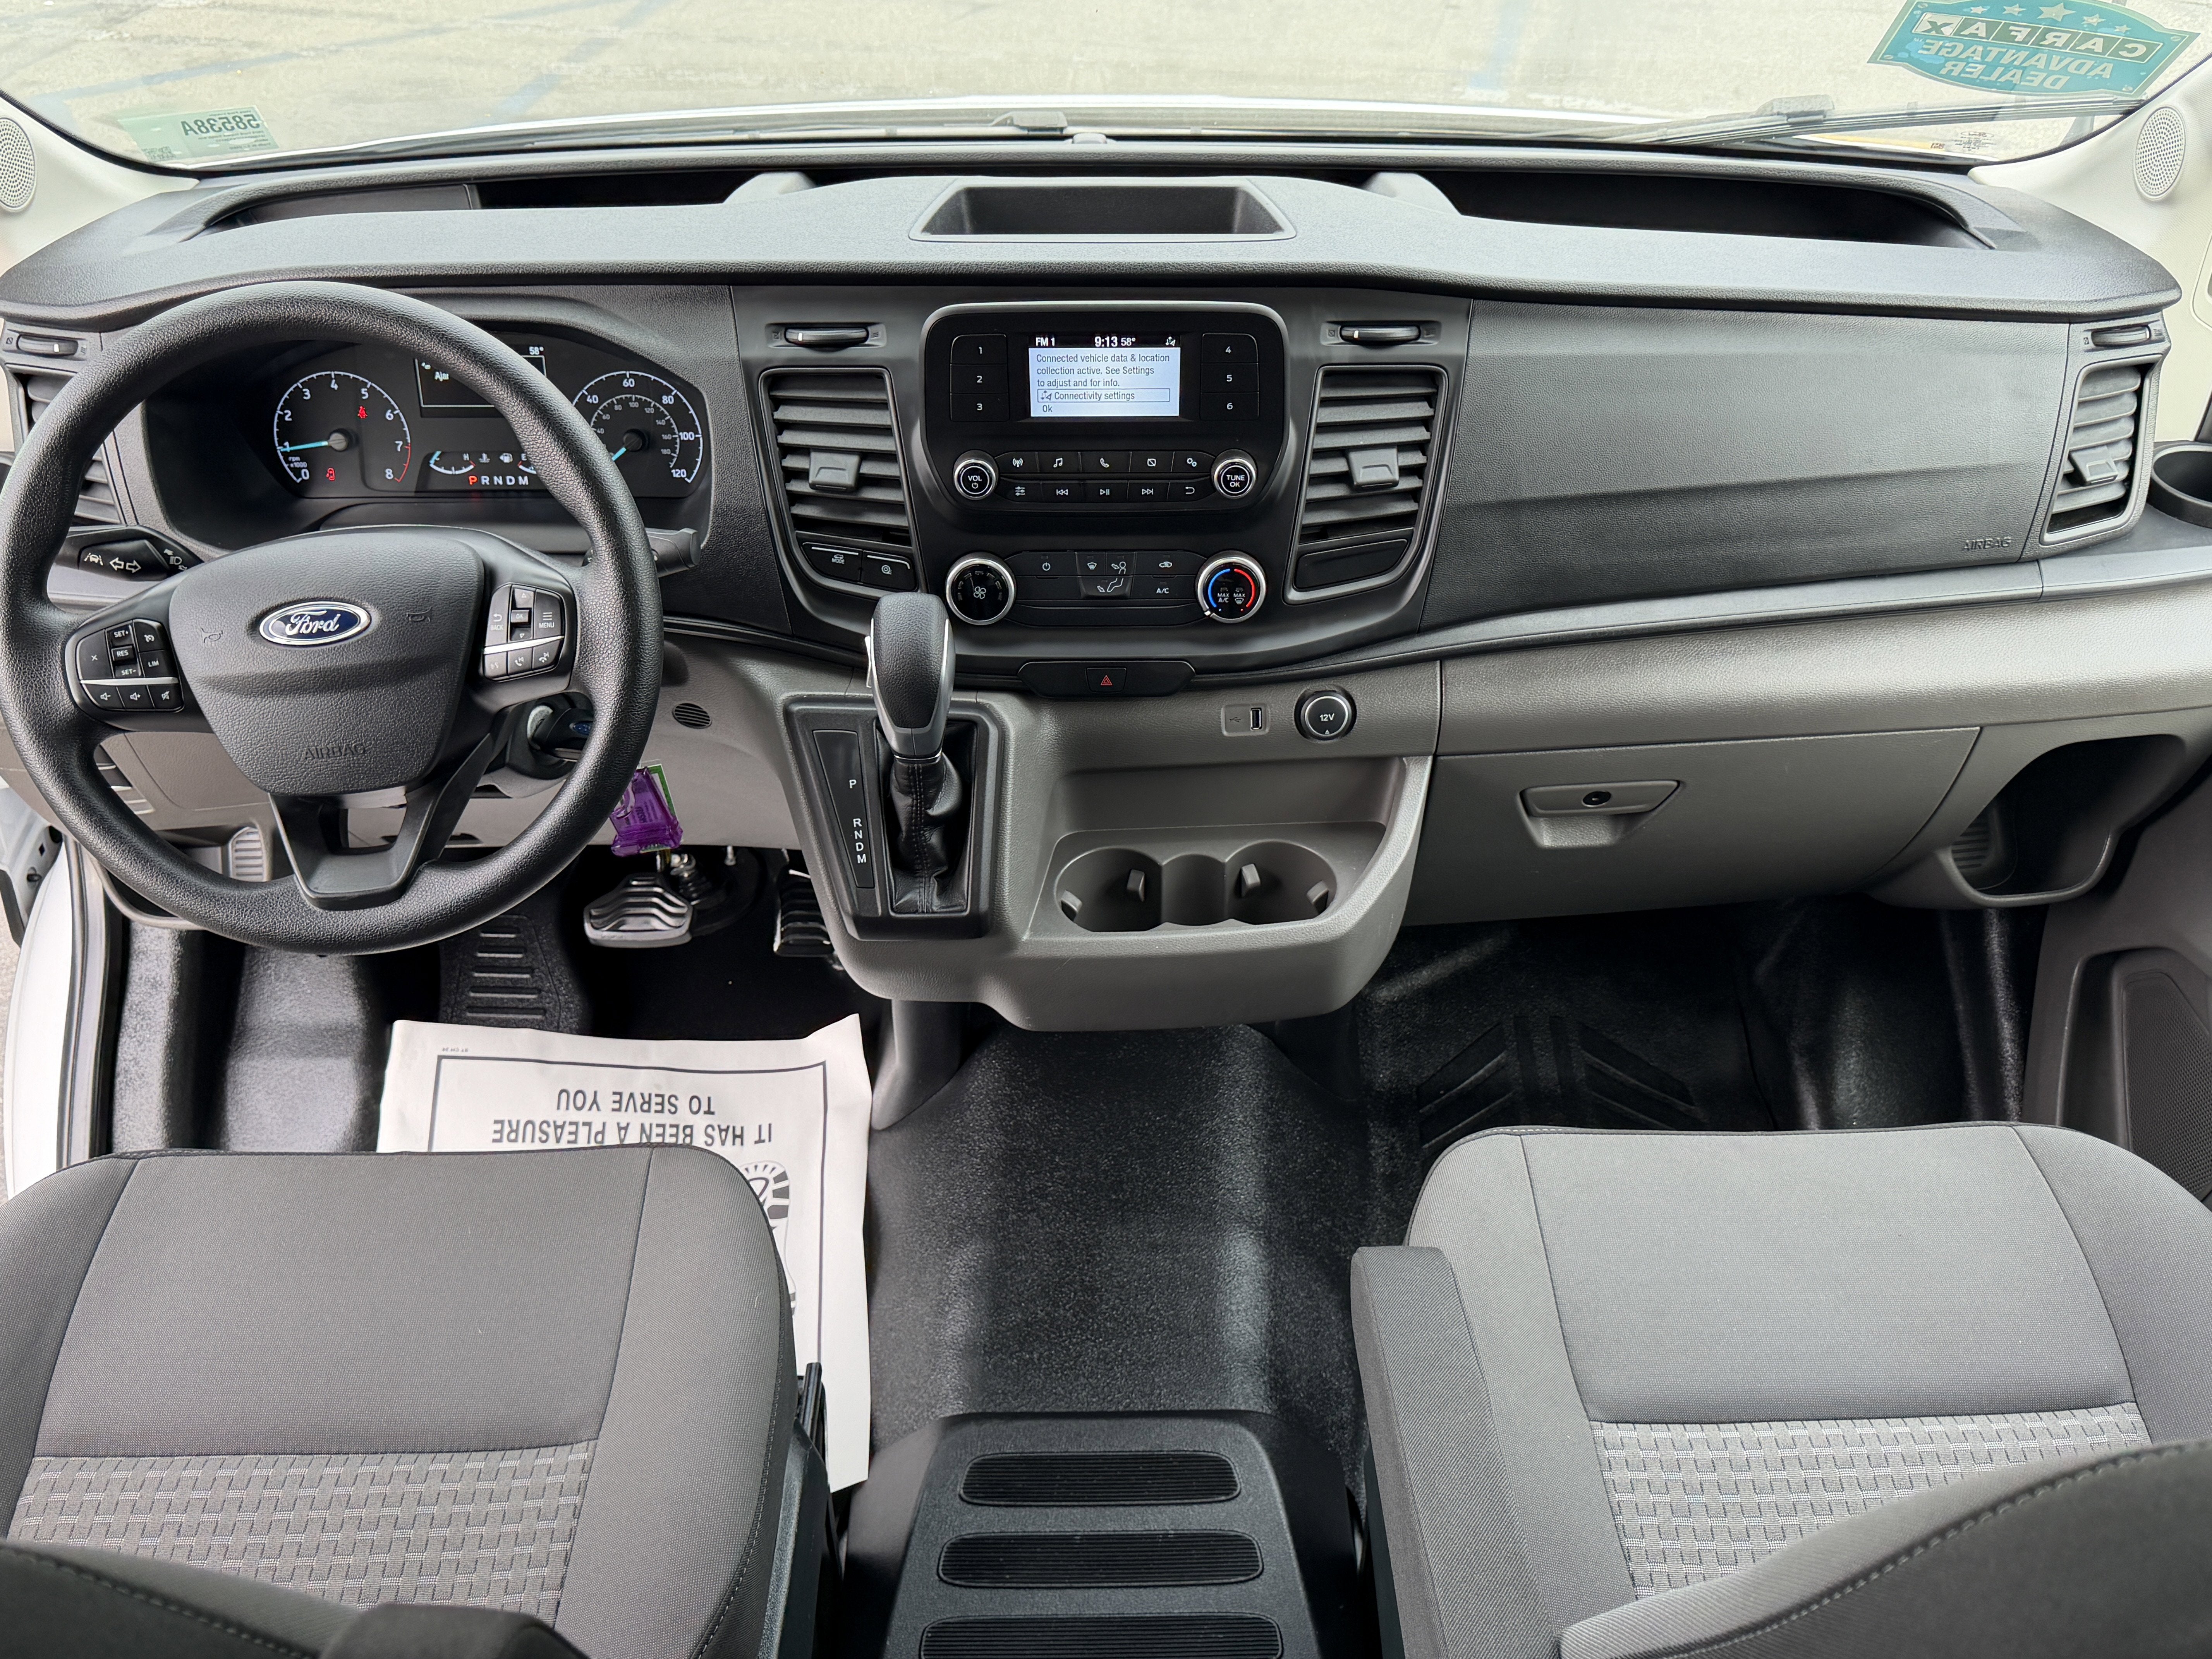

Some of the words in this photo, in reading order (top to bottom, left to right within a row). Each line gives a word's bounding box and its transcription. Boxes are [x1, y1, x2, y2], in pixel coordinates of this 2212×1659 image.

[1036, 337, 1048, 346] FM
[1051, 337, 1055, 346] 1
[1095, 336, 1118, 347] 9:13
[1037, 354, 1078, 362] Connected
[1080, 354, 1108, 362] vehicle
[1111, 354, 1128, 362] data
[1139, 354, 1170, 362] location
[1123, 366, 1154, 376] Settings
[331, 379, 338, 390] 4
[622, 378, 635, 387] 60
[1047, 379, 1071, 388] adjust
[1073, 379, 1087, 387] and
[1090, 378, 1100, 387] for
[1103, 378, 1120, 386] info.
[302, 389, 311, 400] 3
[361, 388, 368, 399] 5
[1054, 392, 1102, 401] Connectivity
[1104, 391, 1135, 401] settings
[586, 395, 599, 404] 40
[661, 395, 674, 404] 80
[1042, 404, 1053, 412] Ok
[284, 410, 292, 421] 2
[385, 409, 394, 421] 6
[679, 432, 694, 441] 100
[395, 441, 403, 452] 7
[301, 469, 310, 480] 0
[385, 468, 393, 479] 8
[671, 469, 687, 478] 120
[469, 476, 478, 485] P
[481, 476, 490, 485] R
[493, 476, 503, 485] N
[506, 476, 515, 485] D
[519, 476, 529, 485] M
[1963, 537, 2013, 550] AIRBAG
[285, 610, 341, 635] Ford
[1319, 713, 1334, 721] 12V
[301, 742, 365, 760] AIRBAG
[849, 780, 857, 788] P
[853, 818, 862, 828] R
[854, 830, 863, 840] N
[856, 842, 864, 852] D
[857, 854, 867, 864] M
[557, 1089, 601, 1111] YOU
[611, 1091, 678, 1115] SERVE
[689, 1096, 715, 1115] TO
[492, 1118, 606, 1145] PLEASURE
[617, 1122, 630, 1144] A
[640, 1123, 694, 1144] BEEN
[704, 1124, 744, 1146] HAS
[754, 1123, 771, 1145] IT
